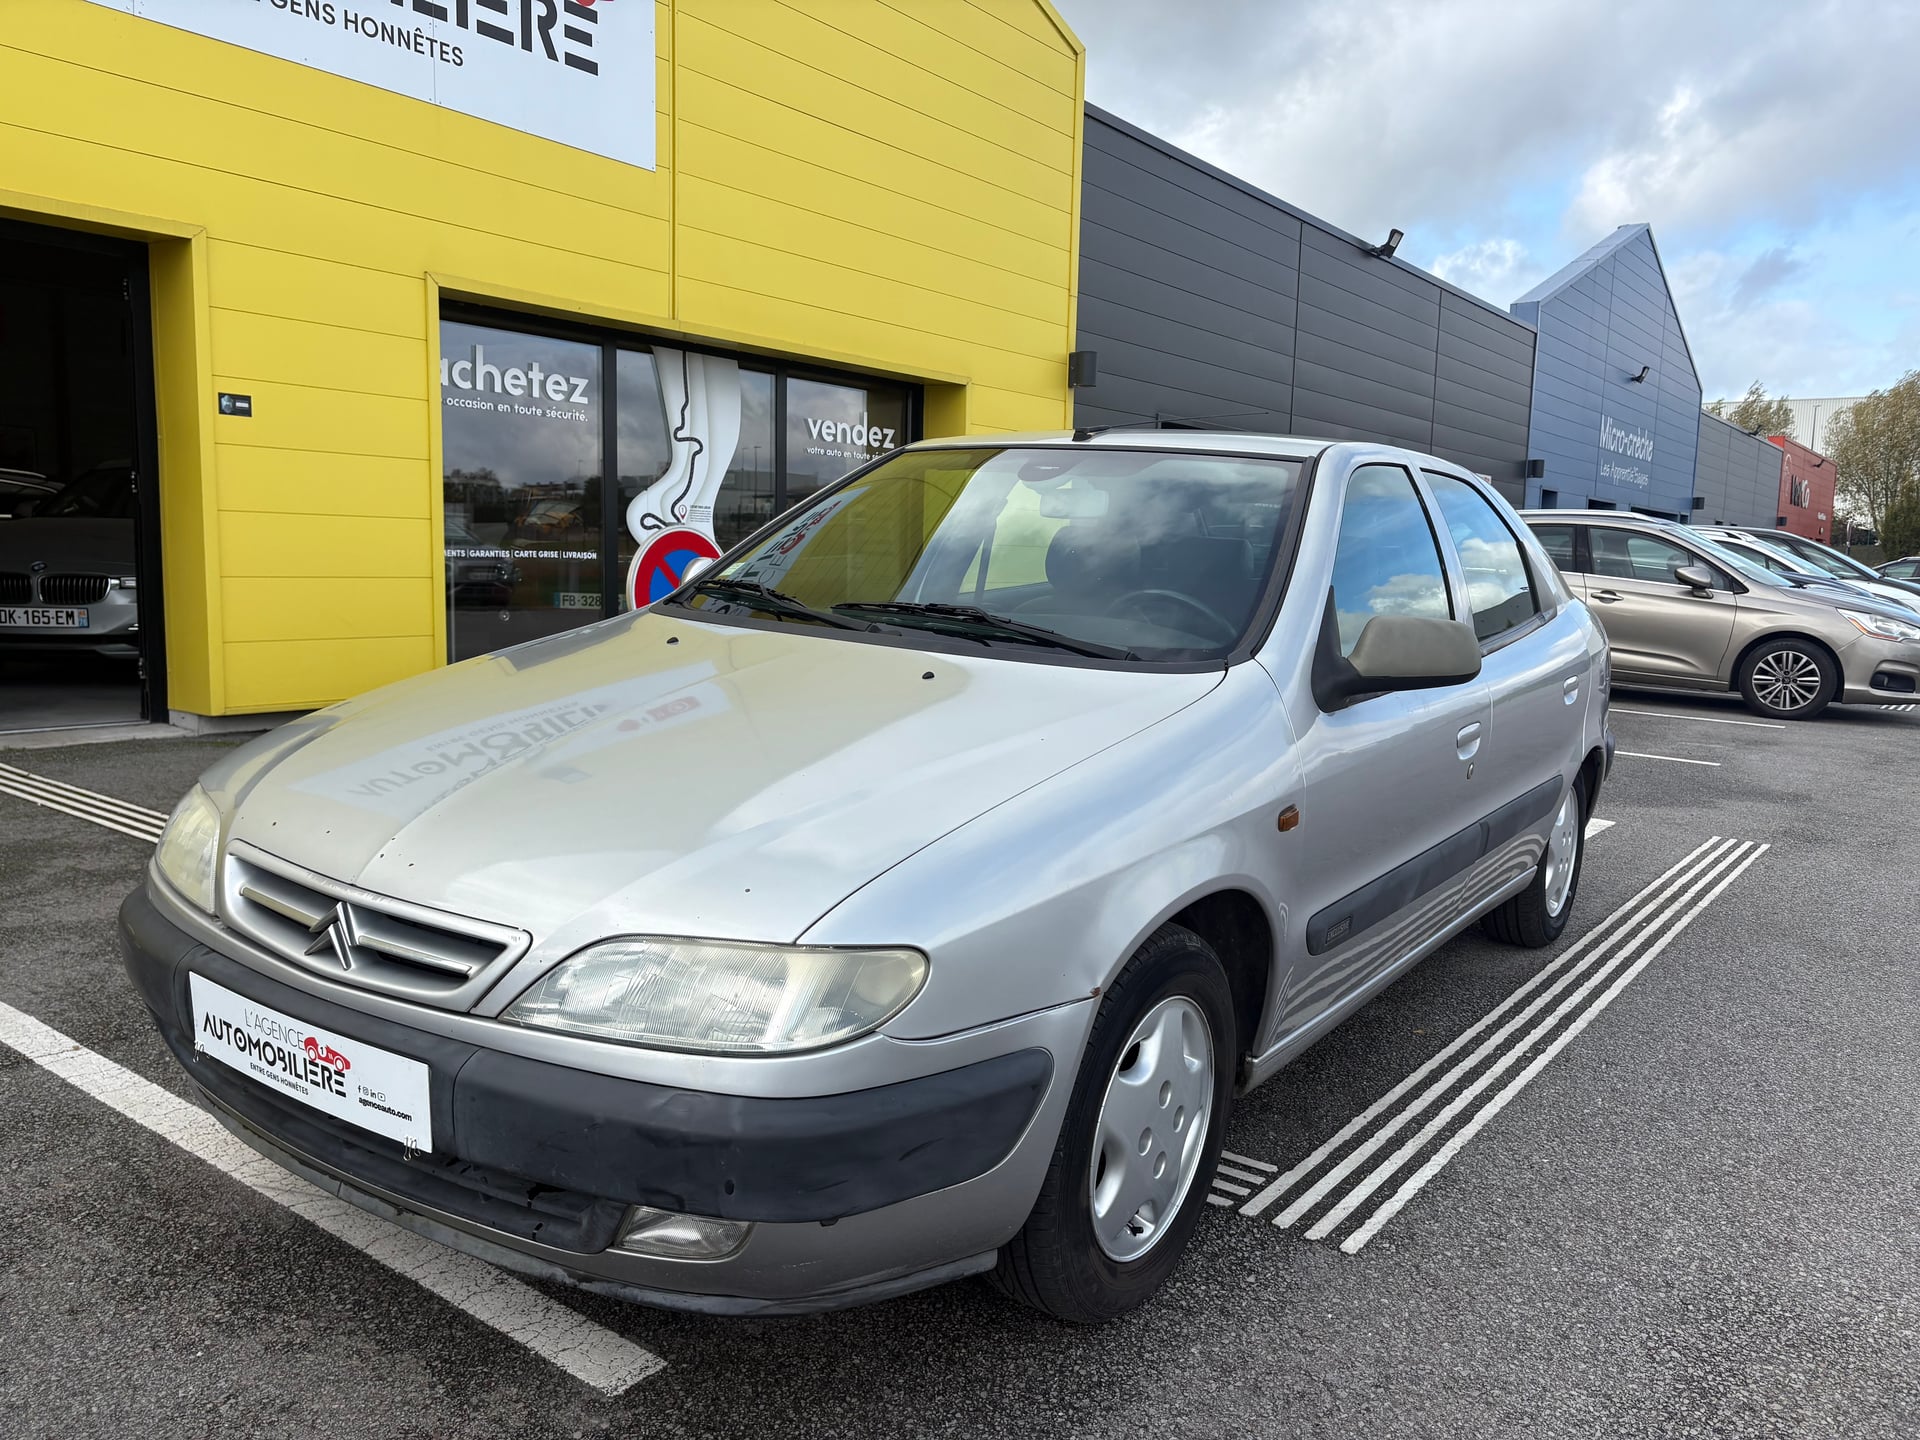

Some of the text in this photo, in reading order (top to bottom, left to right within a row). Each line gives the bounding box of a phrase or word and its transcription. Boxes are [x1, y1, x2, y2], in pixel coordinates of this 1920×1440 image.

[343, 8, 465, 67] HONNÊTES
[447, 397, 589, 422] occasion en toute sécurité.
[807, 411, 896, 450] vendez
[806, 446, 825, 455] votre
[826, 448, 842, 457] auto
[843, 450, 852, 458] en
[853, 450, 871, 460] toute
[469, 550, 510, 558] GARANTIES
[514, 550, 537, 558] CARTE
[538, 550, 559, 558] GRISE
[562, 551, 597, 560] LIVRAISON
[244, 1008, 305, 1051] L'AGENCE
[250, 1062, 265, 1076] ENTRE
[265, 1070, 280, 1082] GENS
[358, 1097, 413, 1122] agenceauto.com
